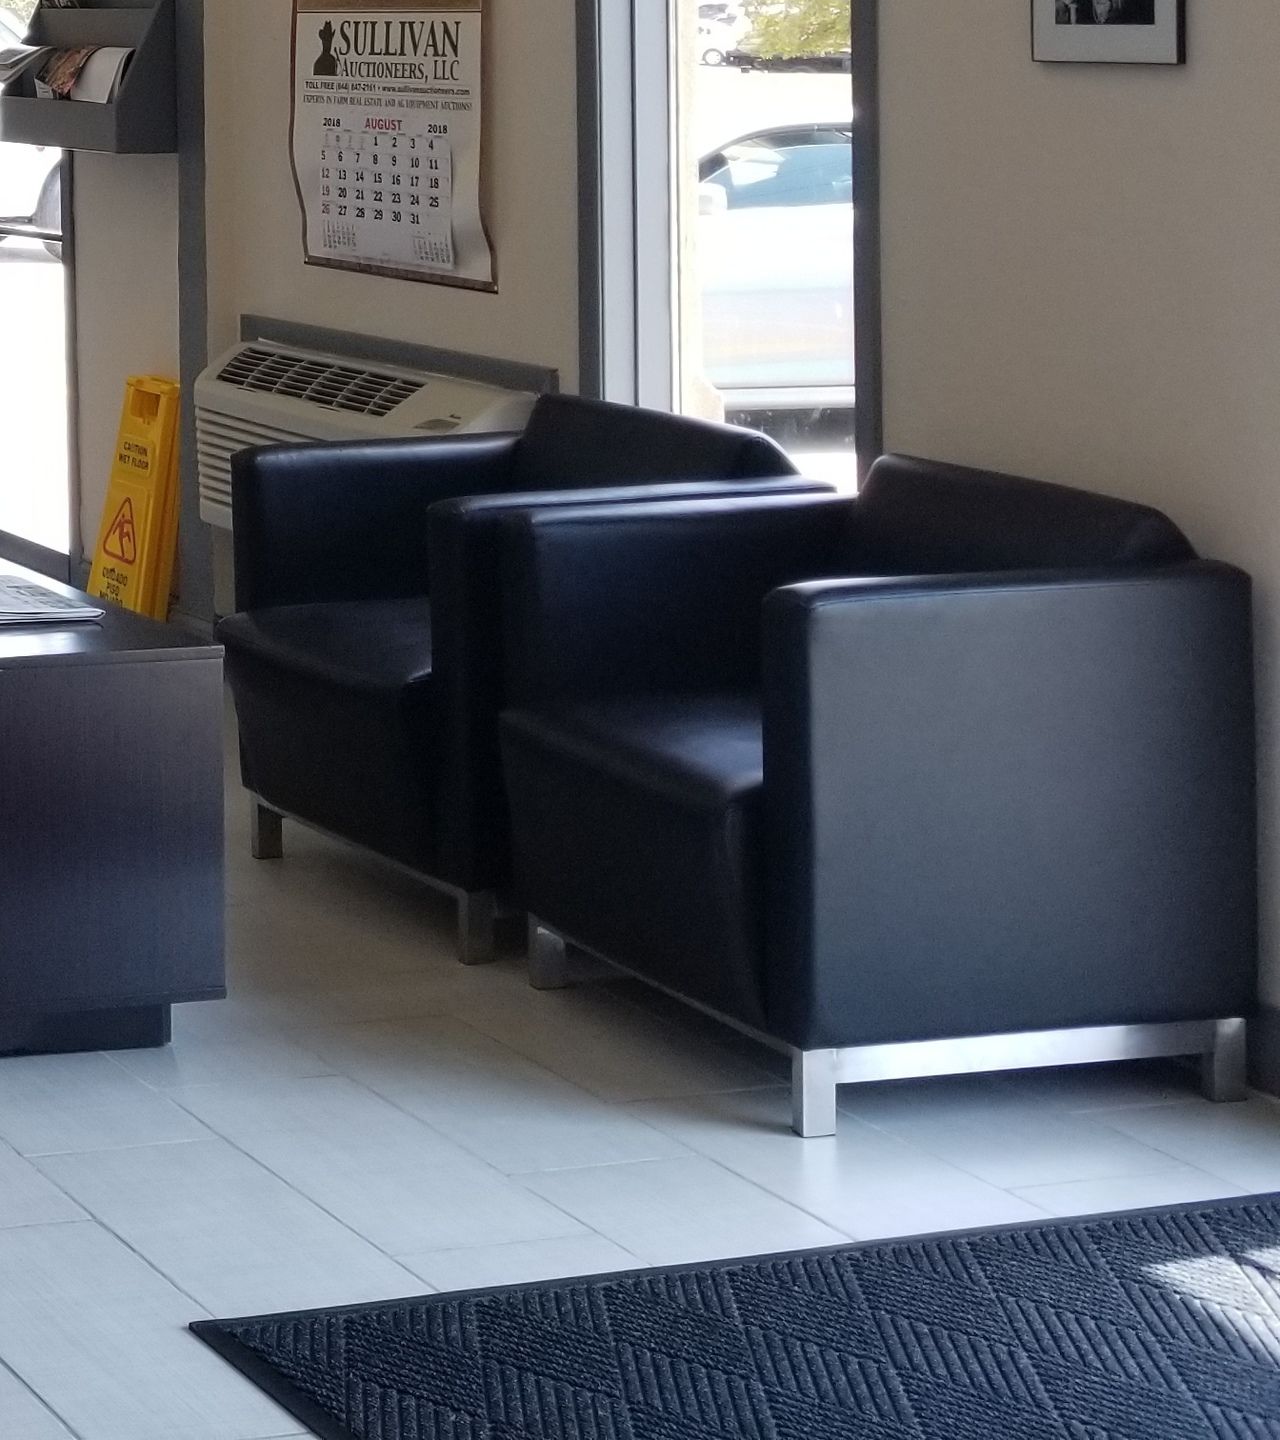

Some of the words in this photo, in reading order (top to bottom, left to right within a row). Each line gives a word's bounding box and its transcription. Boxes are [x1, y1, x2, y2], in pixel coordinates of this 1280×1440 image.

[339, 20, 462, 58] SULLIVAN
[341, 60, 429, 83] AUCTIONEERS,
[433, 60, 460, 80] LLC
[305, 81, 319, 89] TOLL
[321, 82, 335, 90] FREE
[304, 95, 325, 104] EXPERTS
[333, 96, 348, 104] FARM
[349, 97, 362, 105] REAL
[364, 98, 382, 106] ESTATE
[385, 99, 396, 107] AND
[406, 100, 438, 109] EQUIPMENT
[323, 118, 340, 127] 2018
[365, 118, 402, 131] AUGUST
[428, 124, 448, 134] 2018
[374, 136, 378, 146] 1
[392, 137, 398, 148] 2
[410, 138, 415, 149] 3
[428, 140, 434, 150] 4
[321, 150, 326, 160] 5
[338, 151, 343, 162] 6
[356, 153, 360, 162] 7
[373, 154, 378, 165] 8
[392, 155, 396, 166] 9
[411, 158, 420, 168] 10
[429, 159, 438, 170] 11
[322, 168, 330, 178] 12
[338, 170, 347, 180] 13
[356, 172, 364, 182] 14
[374, 173, 382, 183] 15
[392, 175, 400, 185] 16
[410, 177, 419, 187] 17
[429, 178, 439, 189] 18
[322, 186, 330, 196] 19
[338, 188, 347, 198] 20
[356, 189, 364, 200] 21
[374, 191, 383, 202] 22
[392, 193, 401, 204] 23
[410, 195, 419, 206] 24
[429, 197, 439, 208] 25
[322, 204, 330, 214] 26
[338, 205, 347, 216] 27
[356, 207, 365, 218] 28
[374, 209, 383, 220] 29
[392, 211, 401, 222] 30
[410, 214, 420, 224] 31
[124, 441, 148, 456] CAUTION
[119, 454, 130, 464] WET
[131, 457, 149, 470] FLOOR
[103, 567, 127, 586] CUIDADO
[107, 582, 119, 596] PISO
